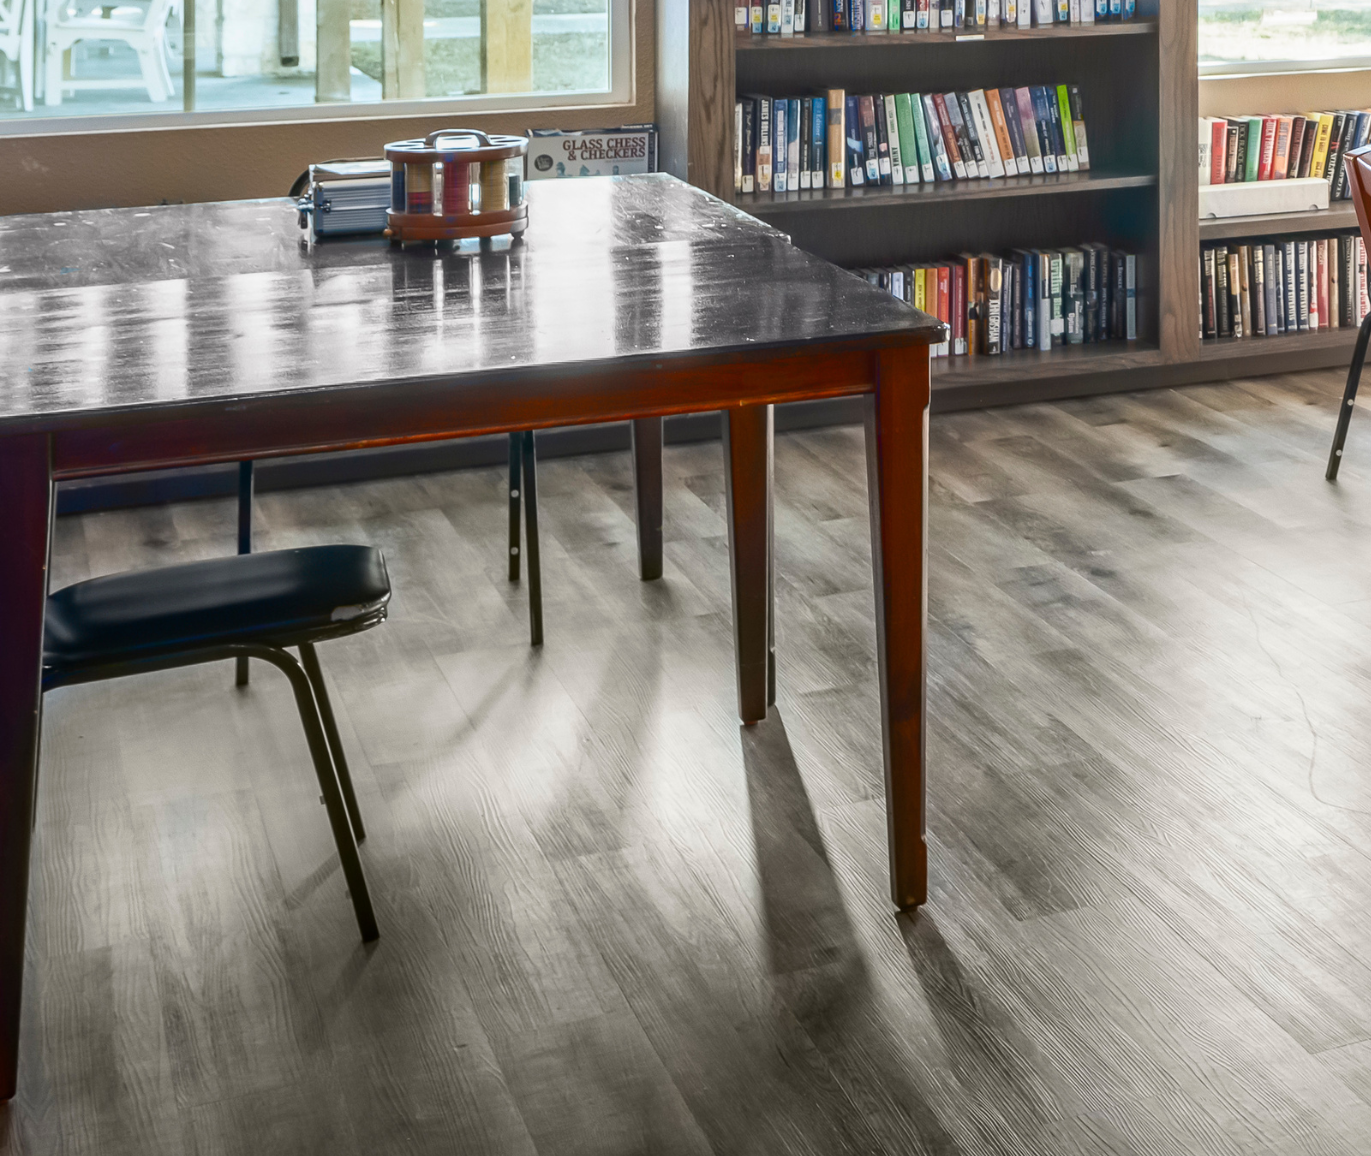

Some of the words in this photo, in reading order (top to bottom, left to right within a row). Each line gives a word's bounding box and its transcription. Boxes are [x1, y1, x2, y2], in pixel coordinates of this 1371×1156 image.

[563, 138, 603, 151] GLASS
[606, 137, 646, 149] CHESS
[580, 147, 646, 161] CHECKERS
